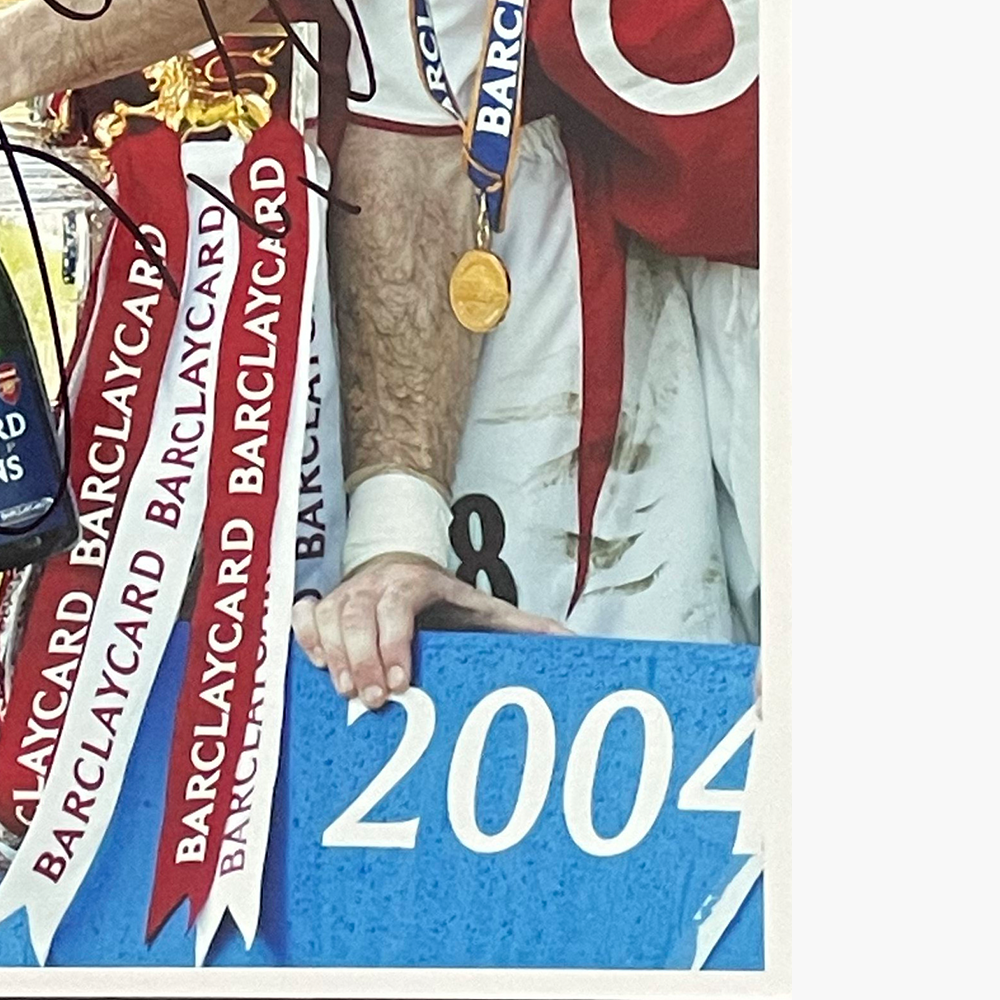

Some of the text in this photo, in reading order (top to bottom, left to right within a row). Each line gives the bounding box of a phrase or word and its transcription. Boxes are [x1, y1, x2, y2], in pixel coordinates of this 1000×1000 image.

[33, 206, 225, 884] BARCLAYCARD BARCLAYCARD
[69, 223, 168, 568] BARCLAYCARD
[175, 157, 287, 864] BARCLAYCARD BARCLAYCARD
